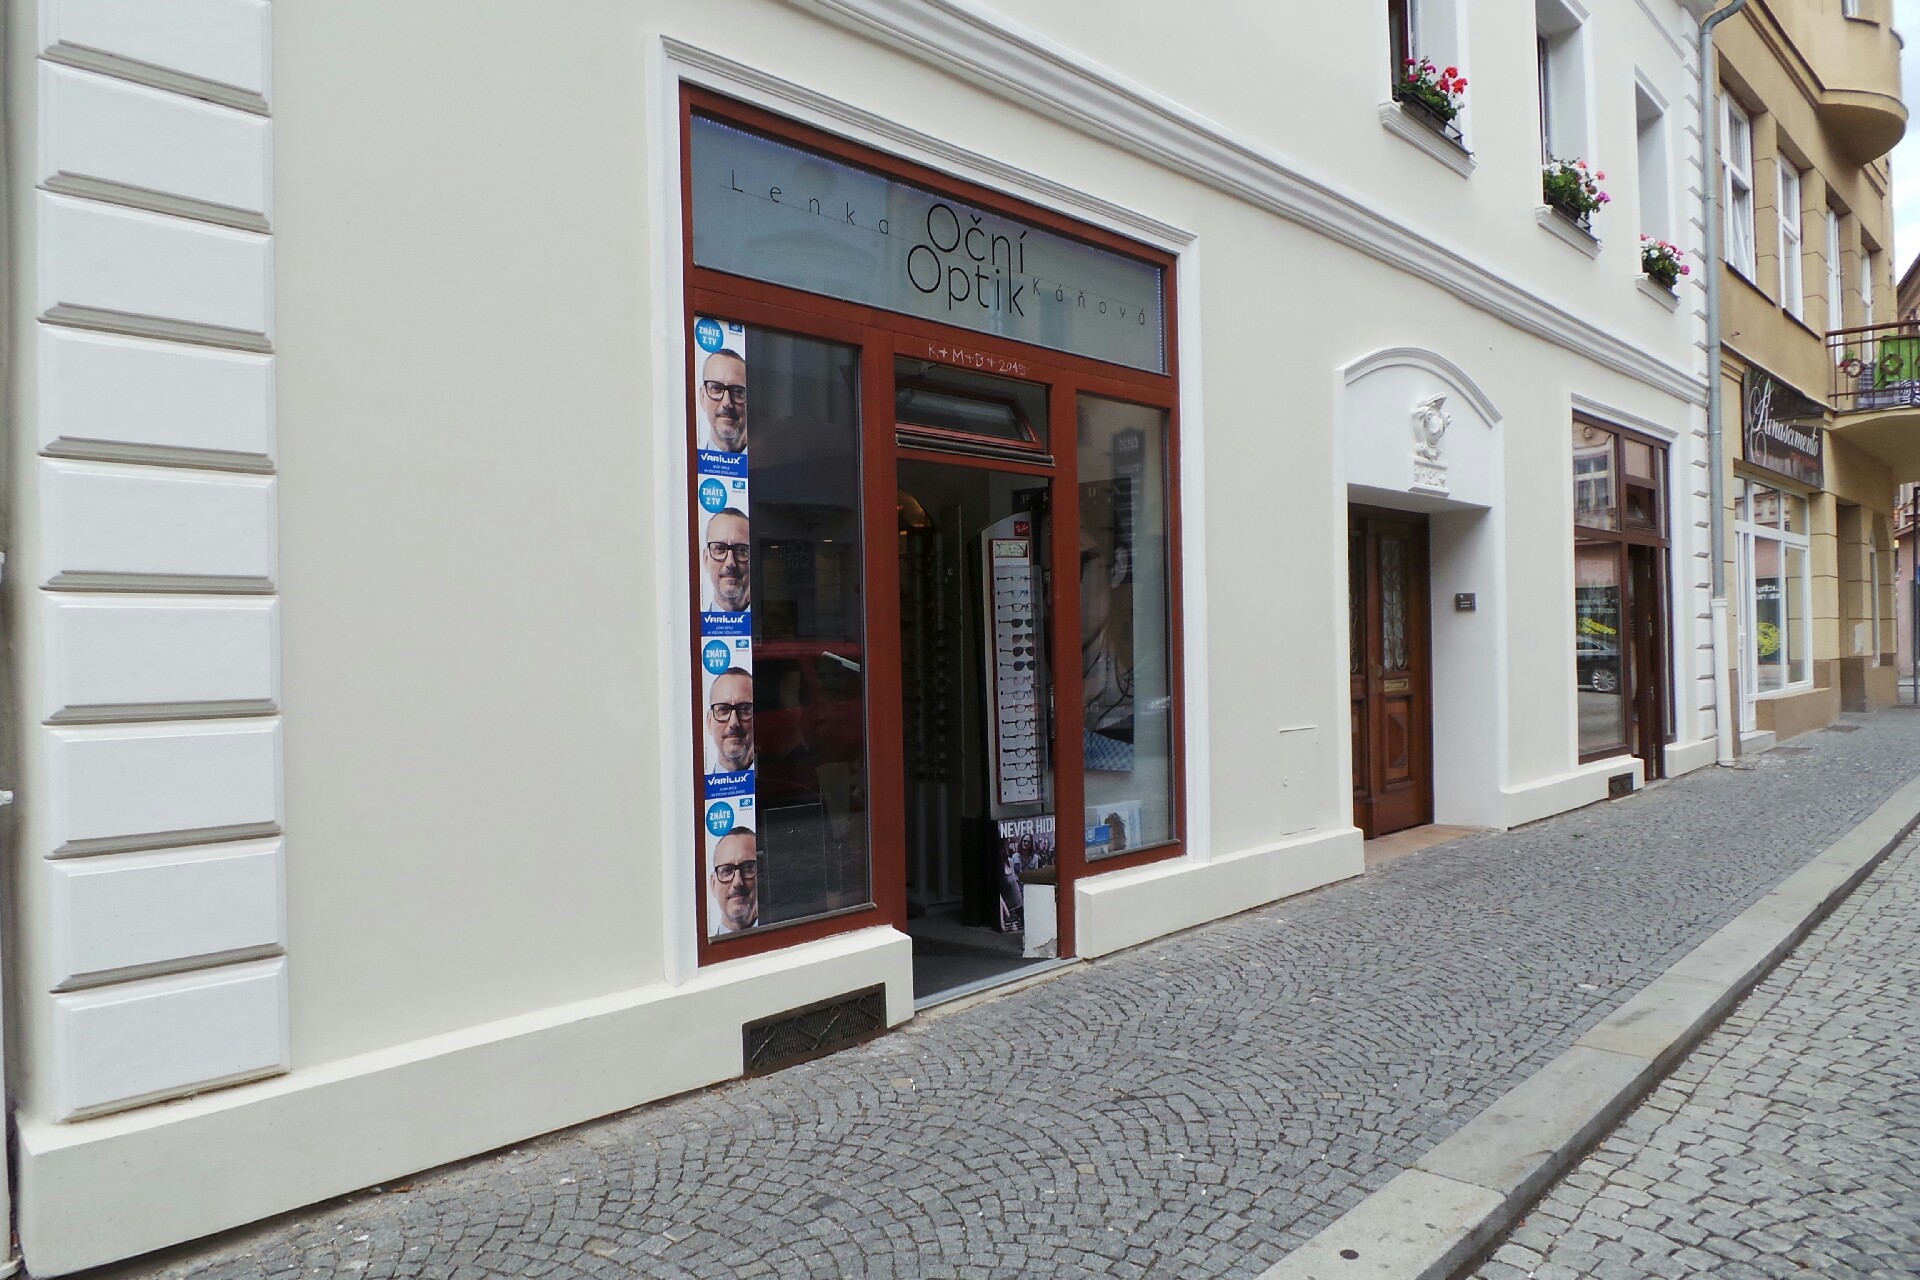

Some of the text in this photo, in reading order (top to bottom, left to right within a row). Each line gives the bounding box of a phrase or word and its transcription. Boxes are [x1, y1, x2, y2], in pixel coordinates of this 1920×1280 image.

[732, 168, 889, 235] Lenka
[926, 203, 1028, 274] Oční
[907, 244, 1025, 317] Optik
[1032, 278, 1146, 326] Káňová
[698, 325, 721, 337] ZNÁTE
[708, 337, 717, 346] TV
[702, 486, 724, 497] ZNÁTE
[712, 497, 721, 506] TV
[706, 647, 728, 658] ZNÁTE
[715, 659, 724, 667] TV
[709, 809, 731, 821] ZNÁTE
[719, 820, 728, 829] TV
[1000, 817, 1056, 839] NEVER HID
